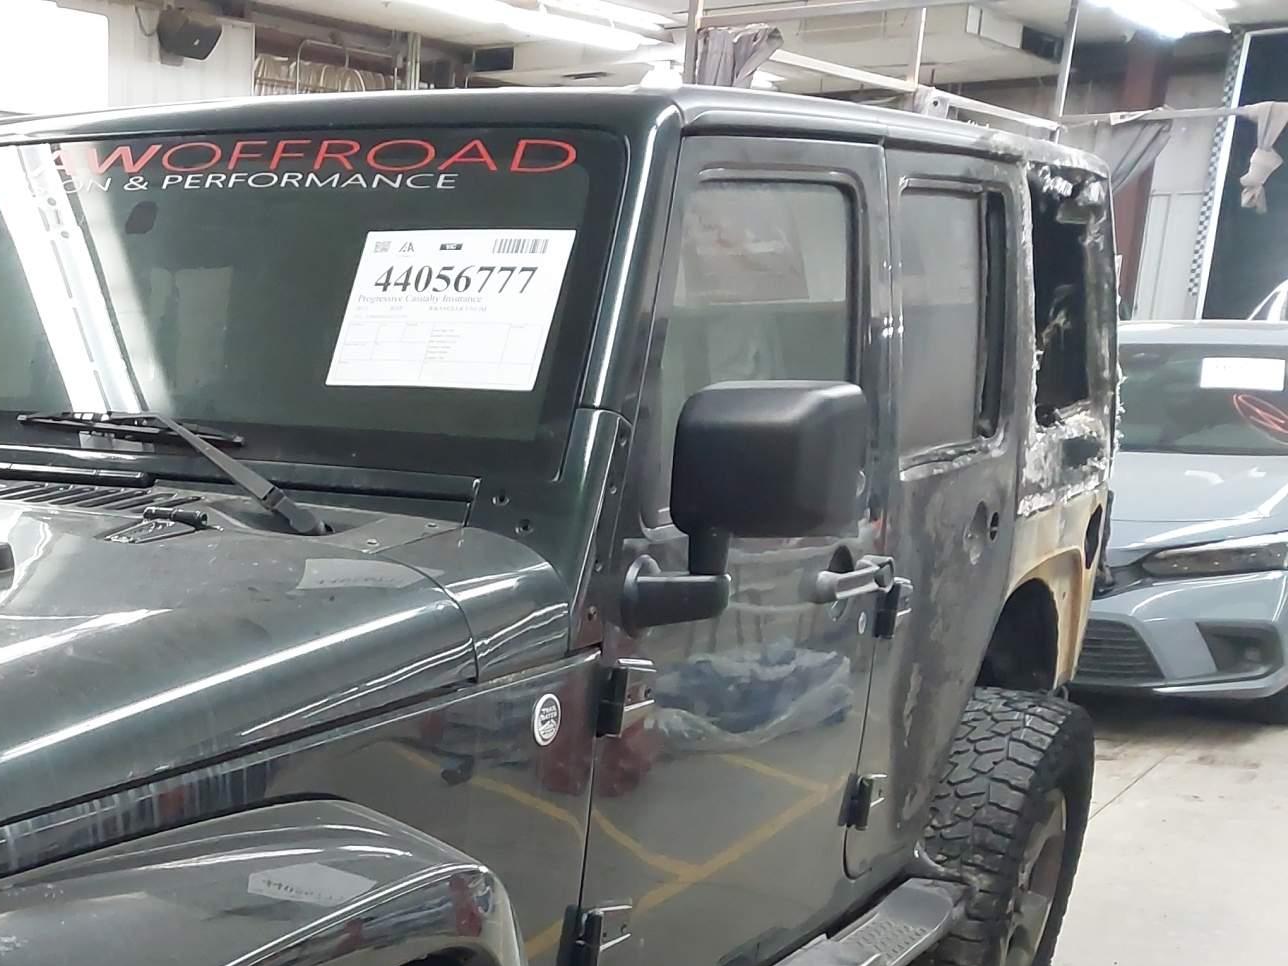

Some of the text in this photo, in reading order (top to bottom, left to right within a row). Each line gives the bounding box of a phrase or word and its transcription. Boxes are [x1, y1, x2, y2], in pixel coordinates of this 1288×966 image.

[122, 173, 150, 191] &
[161, 171, 460, 191] PERFORMANCE
[373, 264, 539, 294] 44056777
